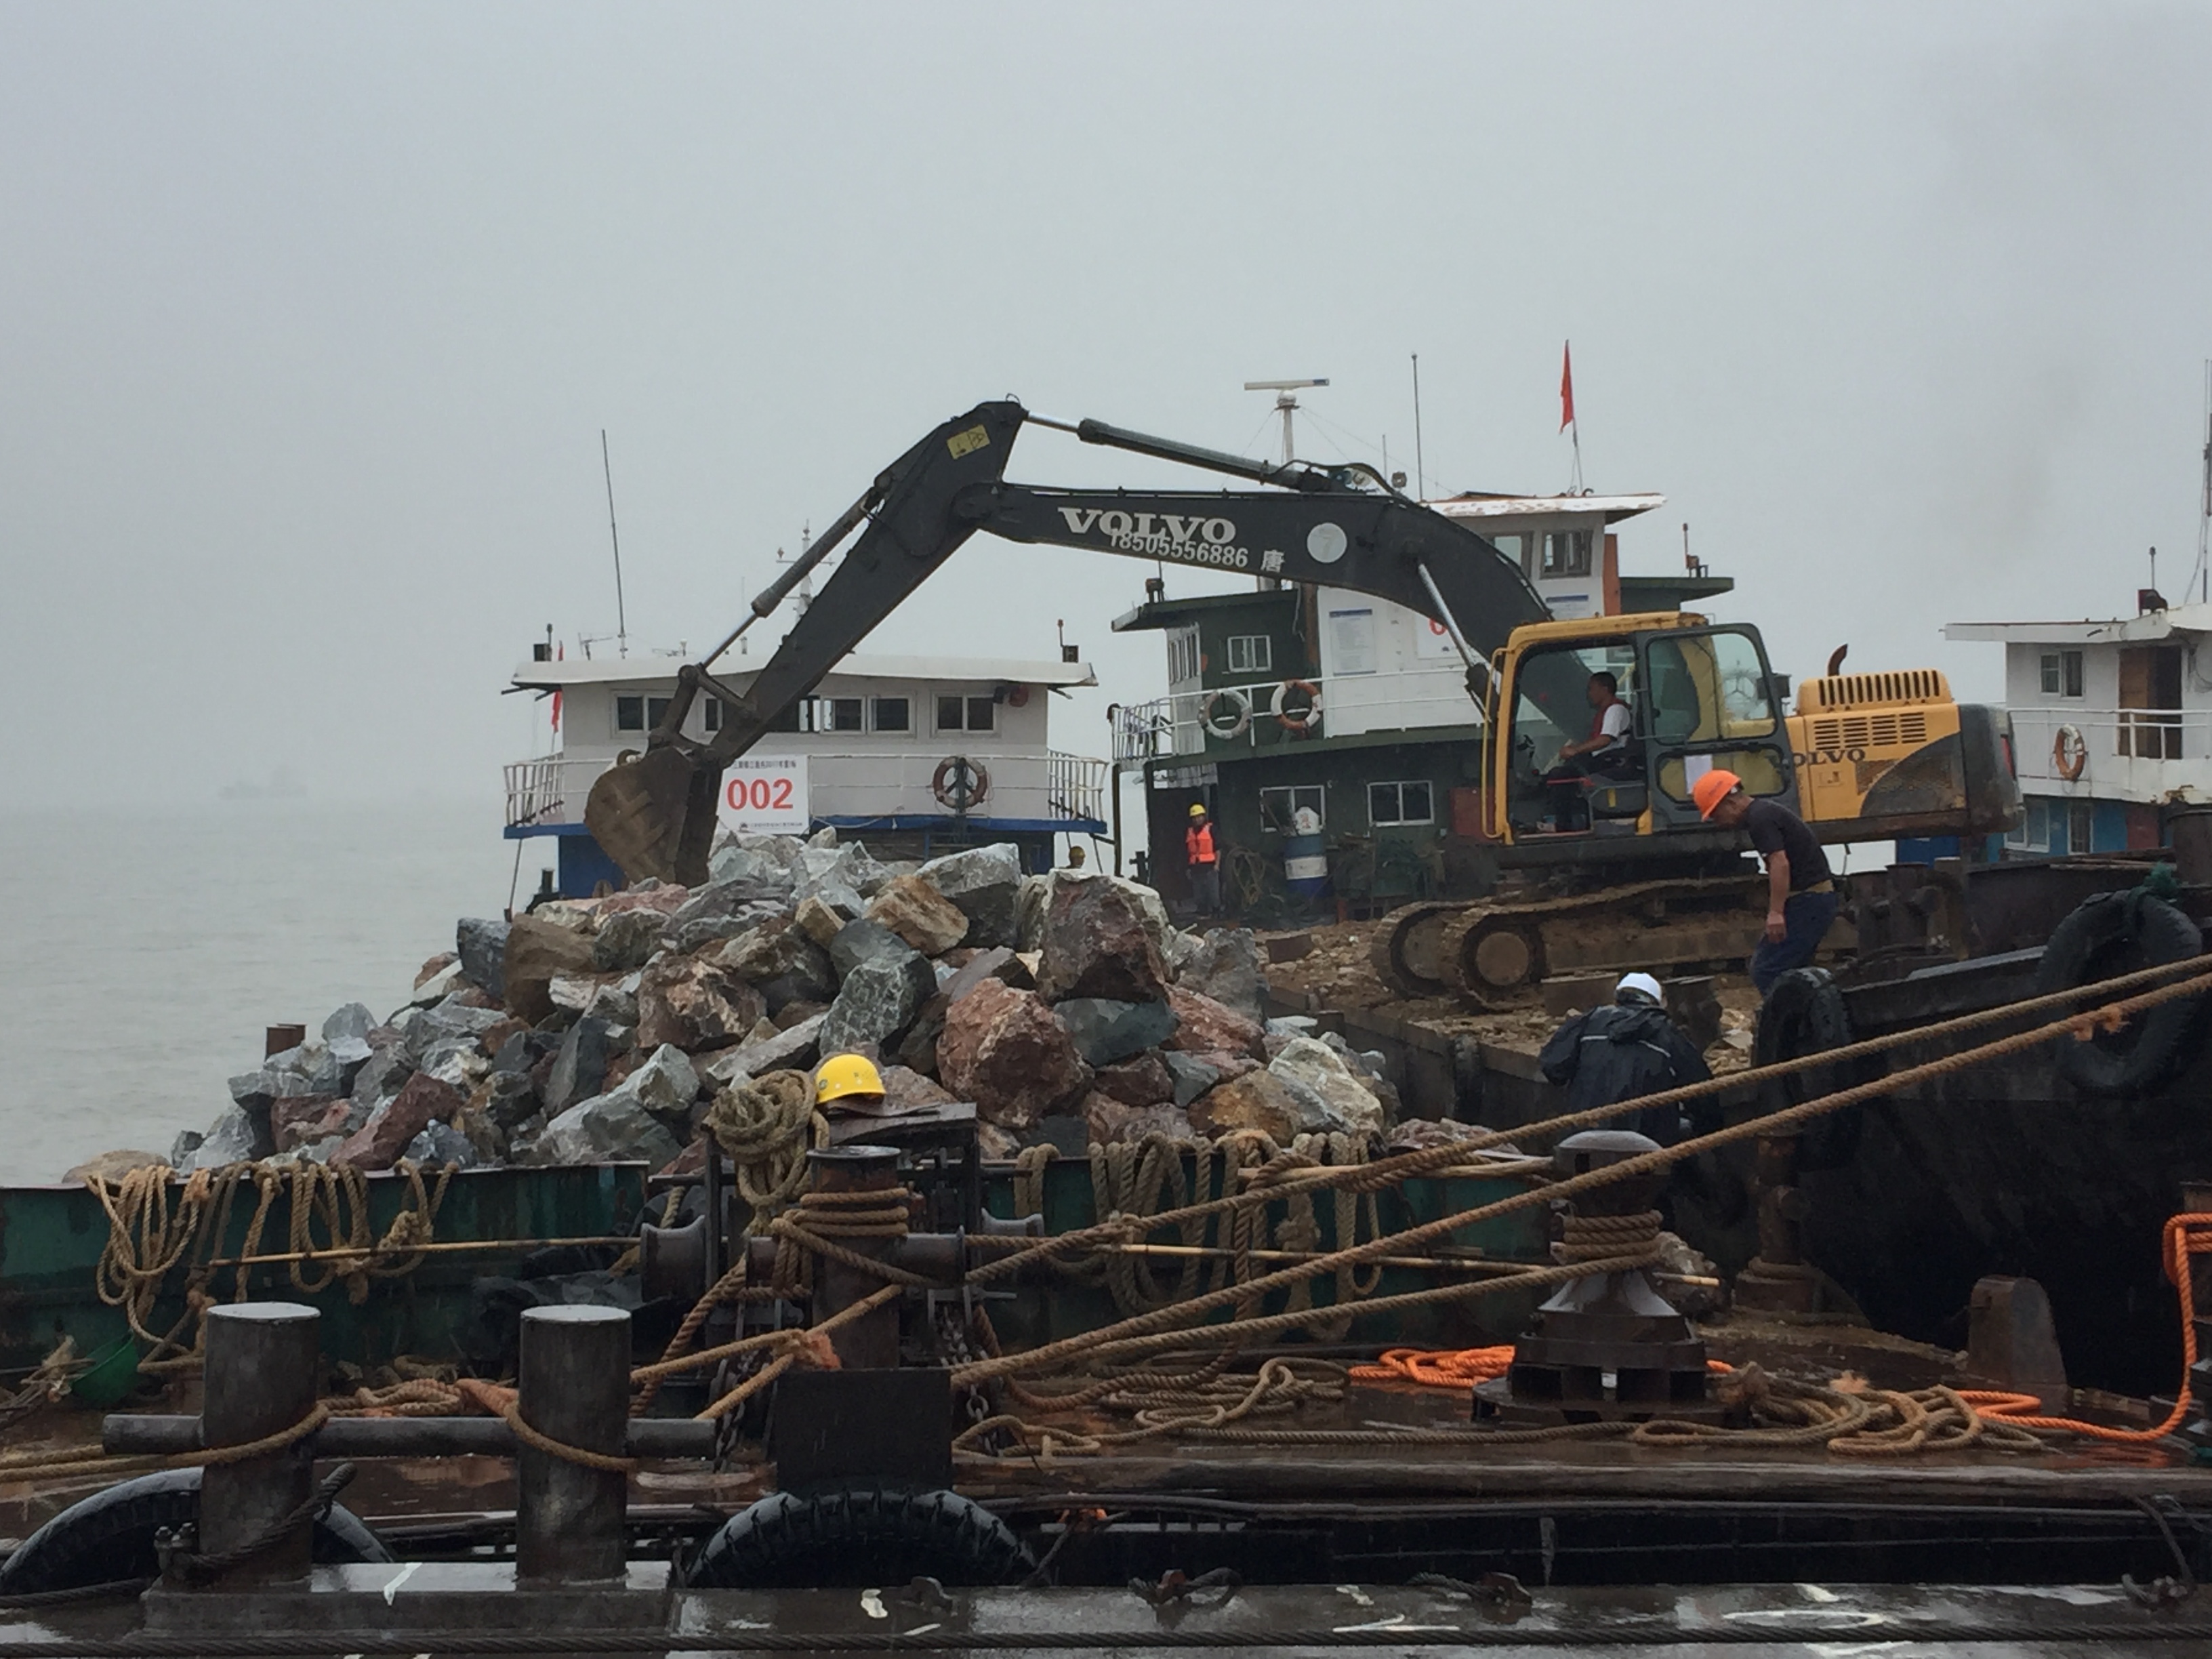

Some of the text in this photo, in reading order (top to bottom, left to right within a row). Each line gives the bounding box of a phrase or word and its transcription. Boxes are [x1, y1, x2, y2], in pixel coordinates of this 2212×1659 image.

[1057, 506, 1236, 544] VOLVO
[1110, 527, 1285, 573] 18505556886 唐
[1793, 748, 1866, 767] OLVO
[727, 778, 794, 811] 002
